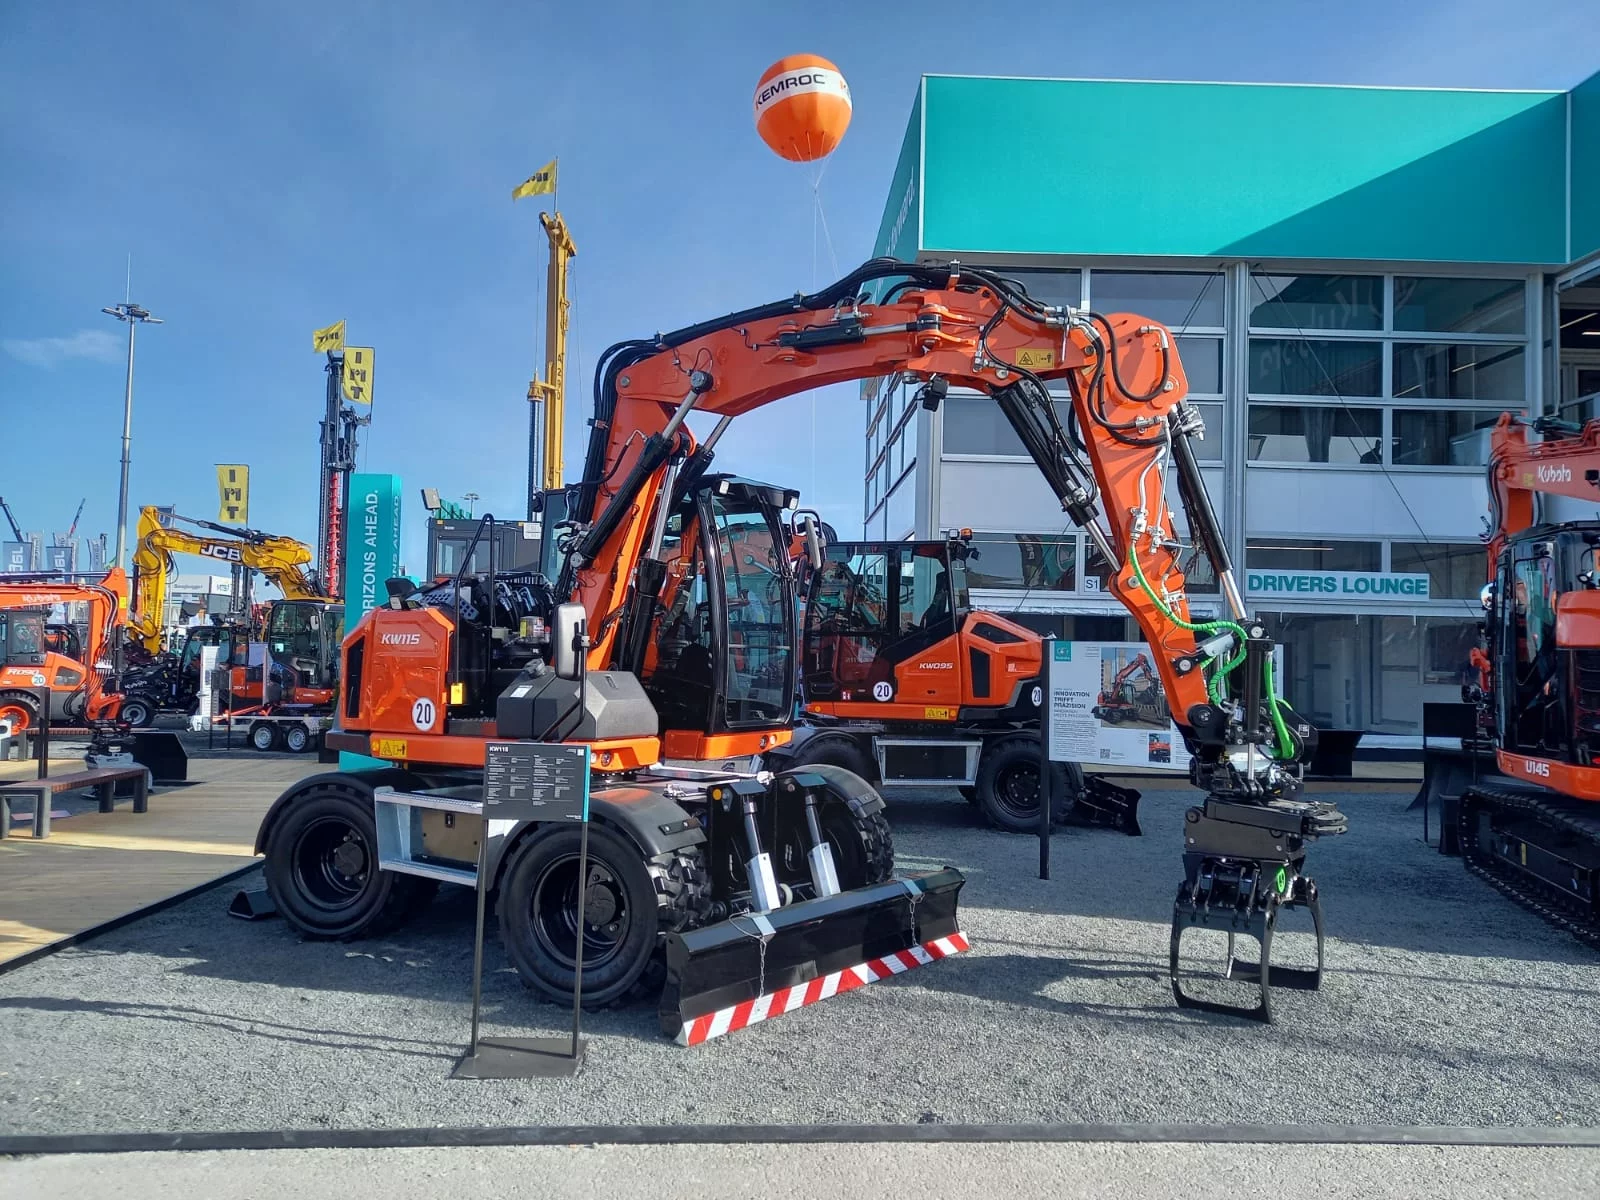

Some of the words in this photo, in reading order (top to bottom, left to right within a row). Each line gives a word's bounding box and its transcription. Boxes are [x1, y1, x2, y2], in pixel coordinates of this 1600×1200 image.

[756, 73, 826, 110] KEMROC
[1538, 464, 1572, 483] Kubota
[364, 489, 379, 547] AHEAD.
[201, 544, 241, 561] JCB
[1086, 579, 1098, 589] S1
[1248, 574, 1337, 593] DRIVERS
[1342, 577, 1428, 595] LOUNGE
[381, 633, 421, 645] KW115
[877, 685, 890, 697] 20
[1033, 688, 1041, 702] 20
[416, 703, 431, 724] 20
[1526, 760, 1550, 777] U145
